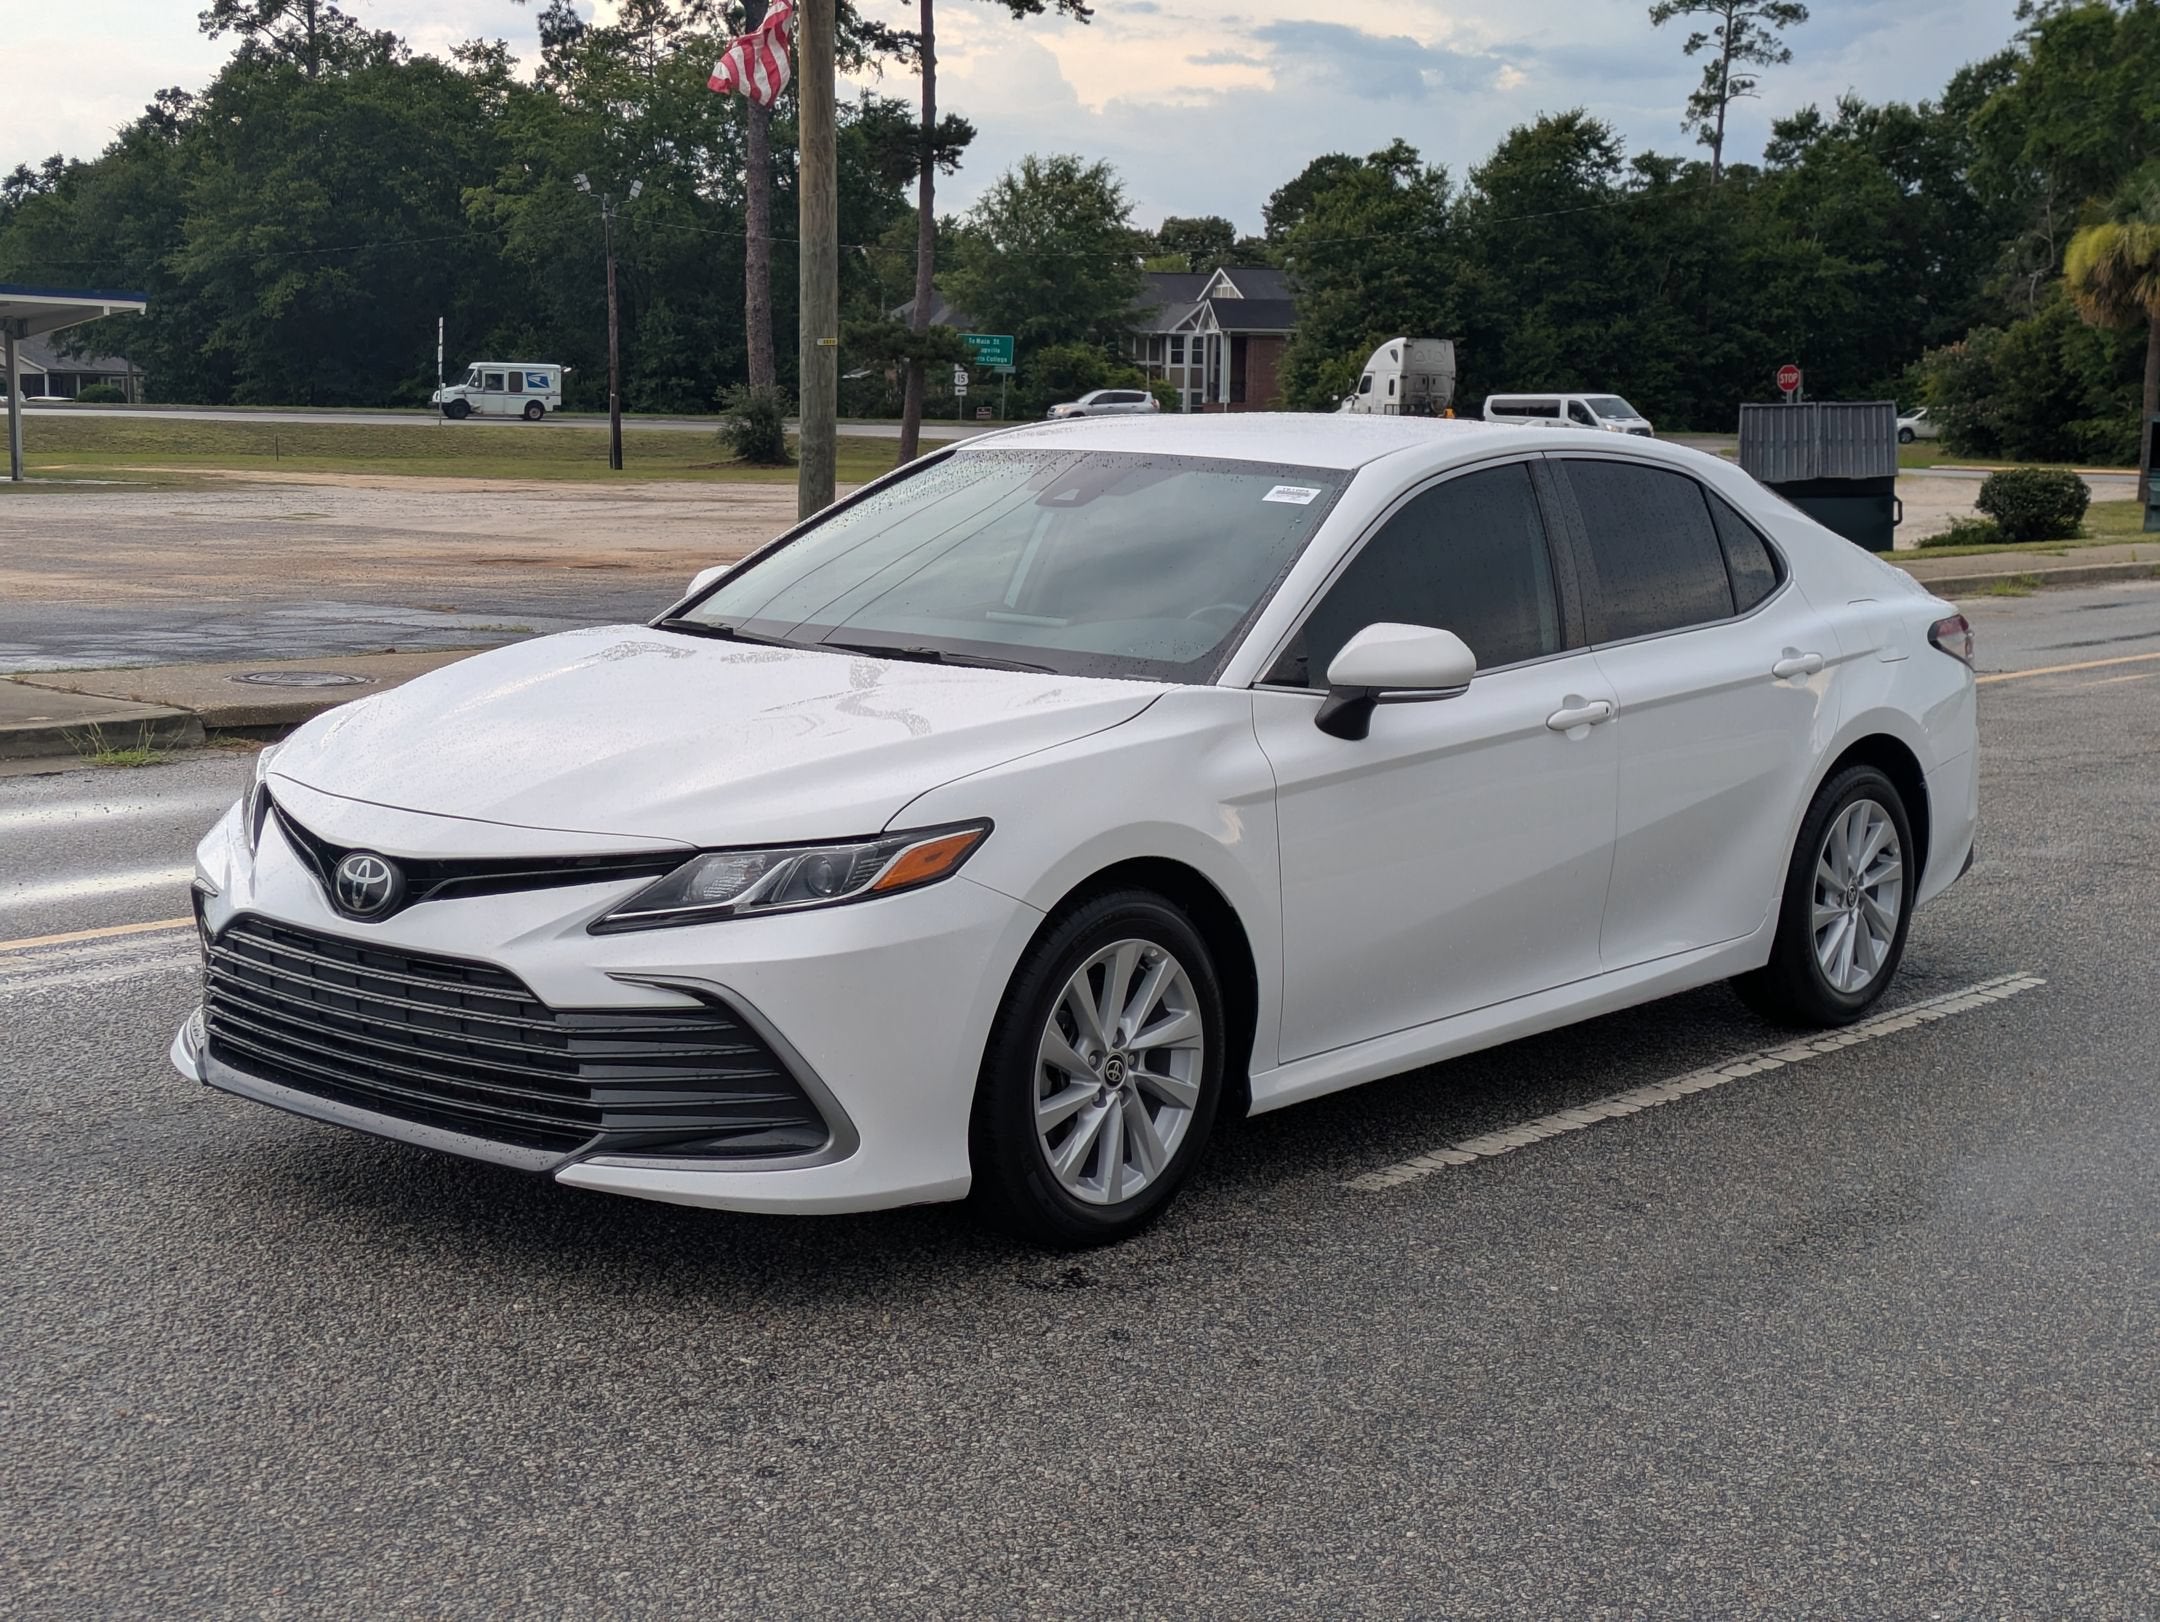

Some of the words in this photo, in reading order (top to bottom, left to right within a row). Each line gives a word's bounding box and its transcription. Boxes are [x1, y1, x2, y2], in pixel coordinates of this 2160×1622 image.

[986, 355, 1008, 363] College
[957, 374, 966, 383] 15
[1780, 373, 1798, 384] STOP
